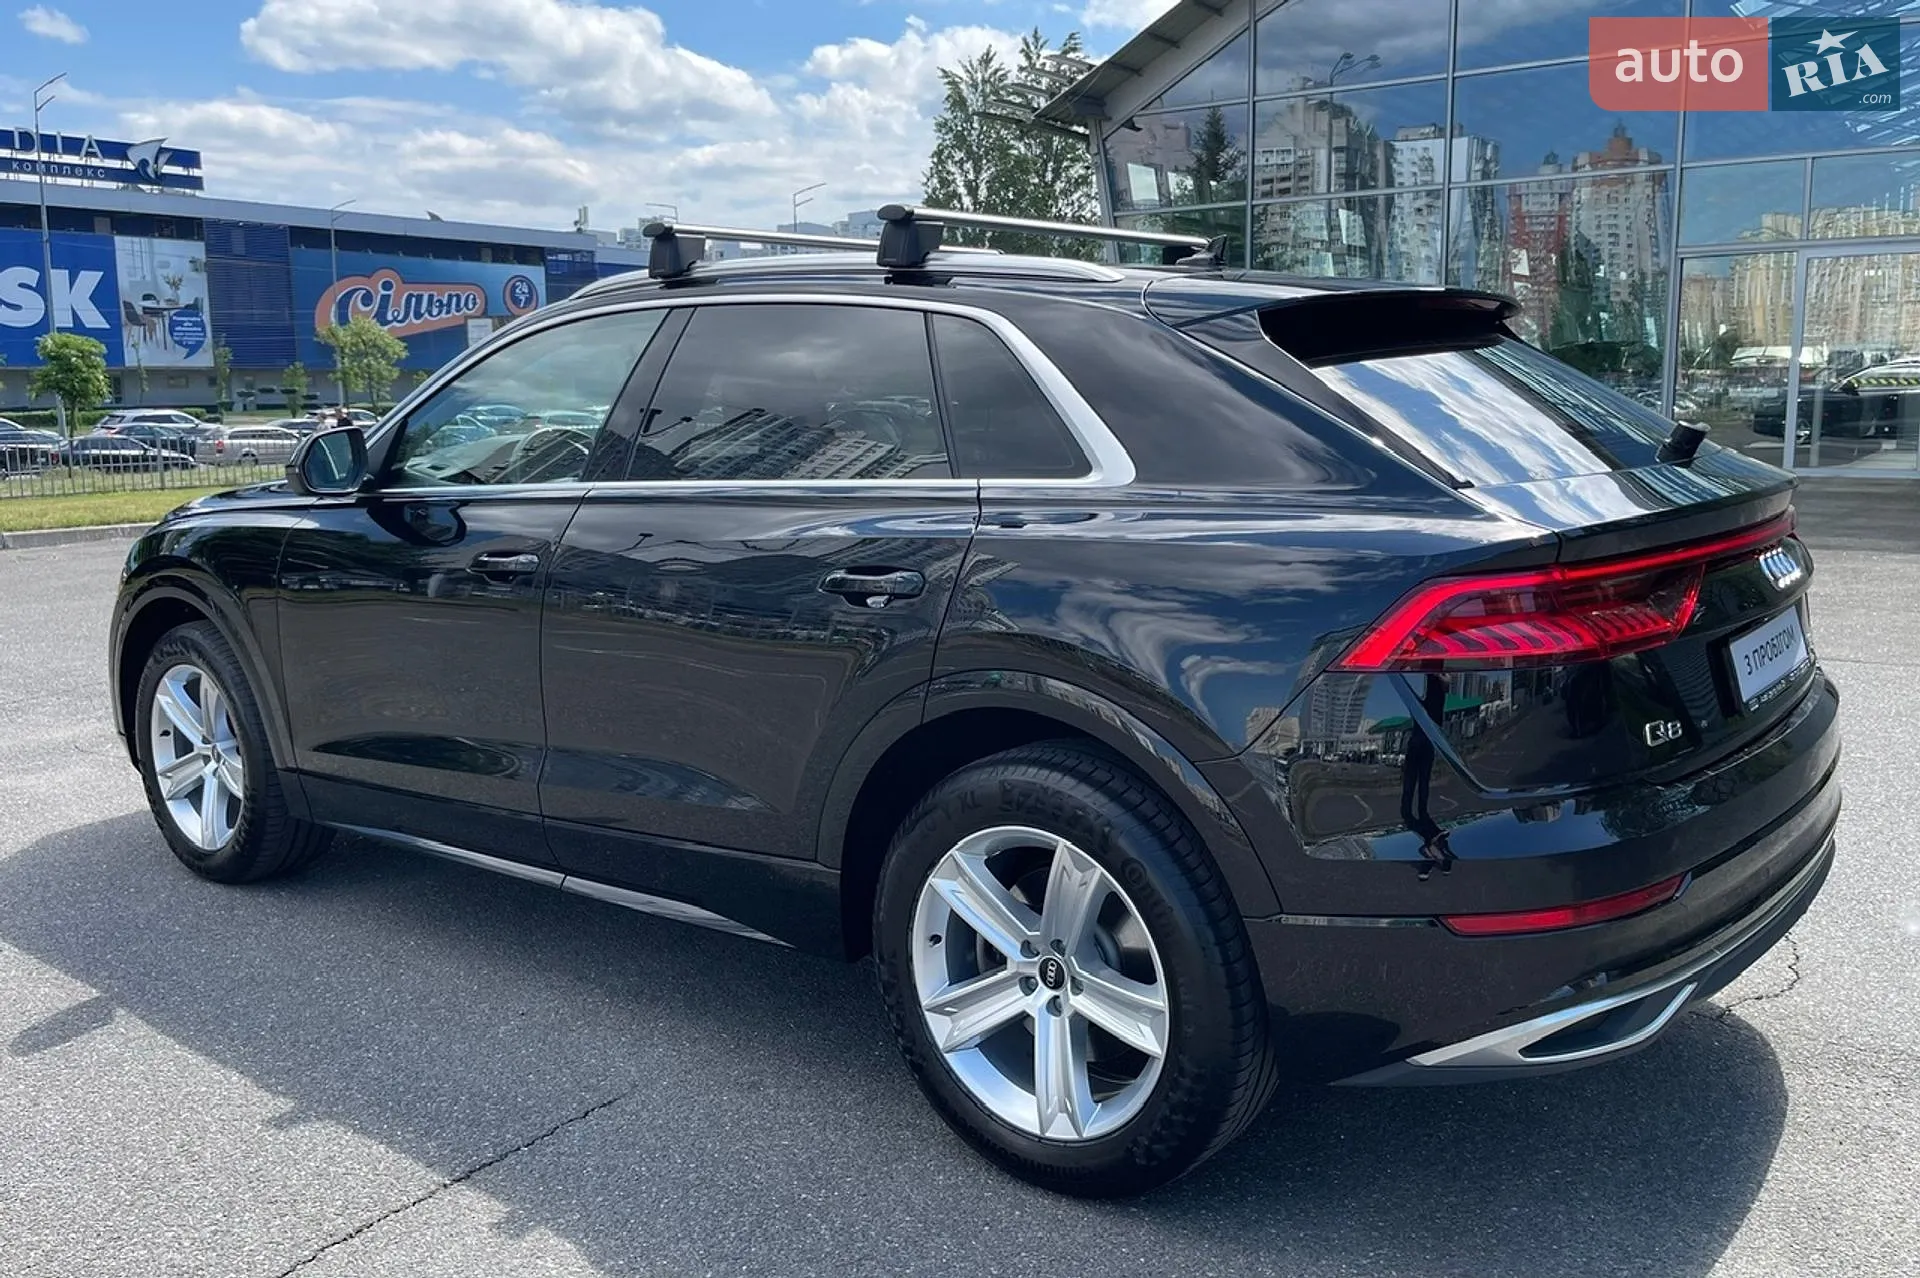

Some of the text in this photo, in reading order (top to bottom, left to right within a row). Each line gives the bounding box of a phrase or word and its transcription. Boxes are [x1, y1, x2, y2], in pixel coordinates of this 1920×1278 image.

[12, 161, 105, 178] комплекс
[330, 278, 480, 328] Сільпо
[1645, 720, 1682, 747] Q8
